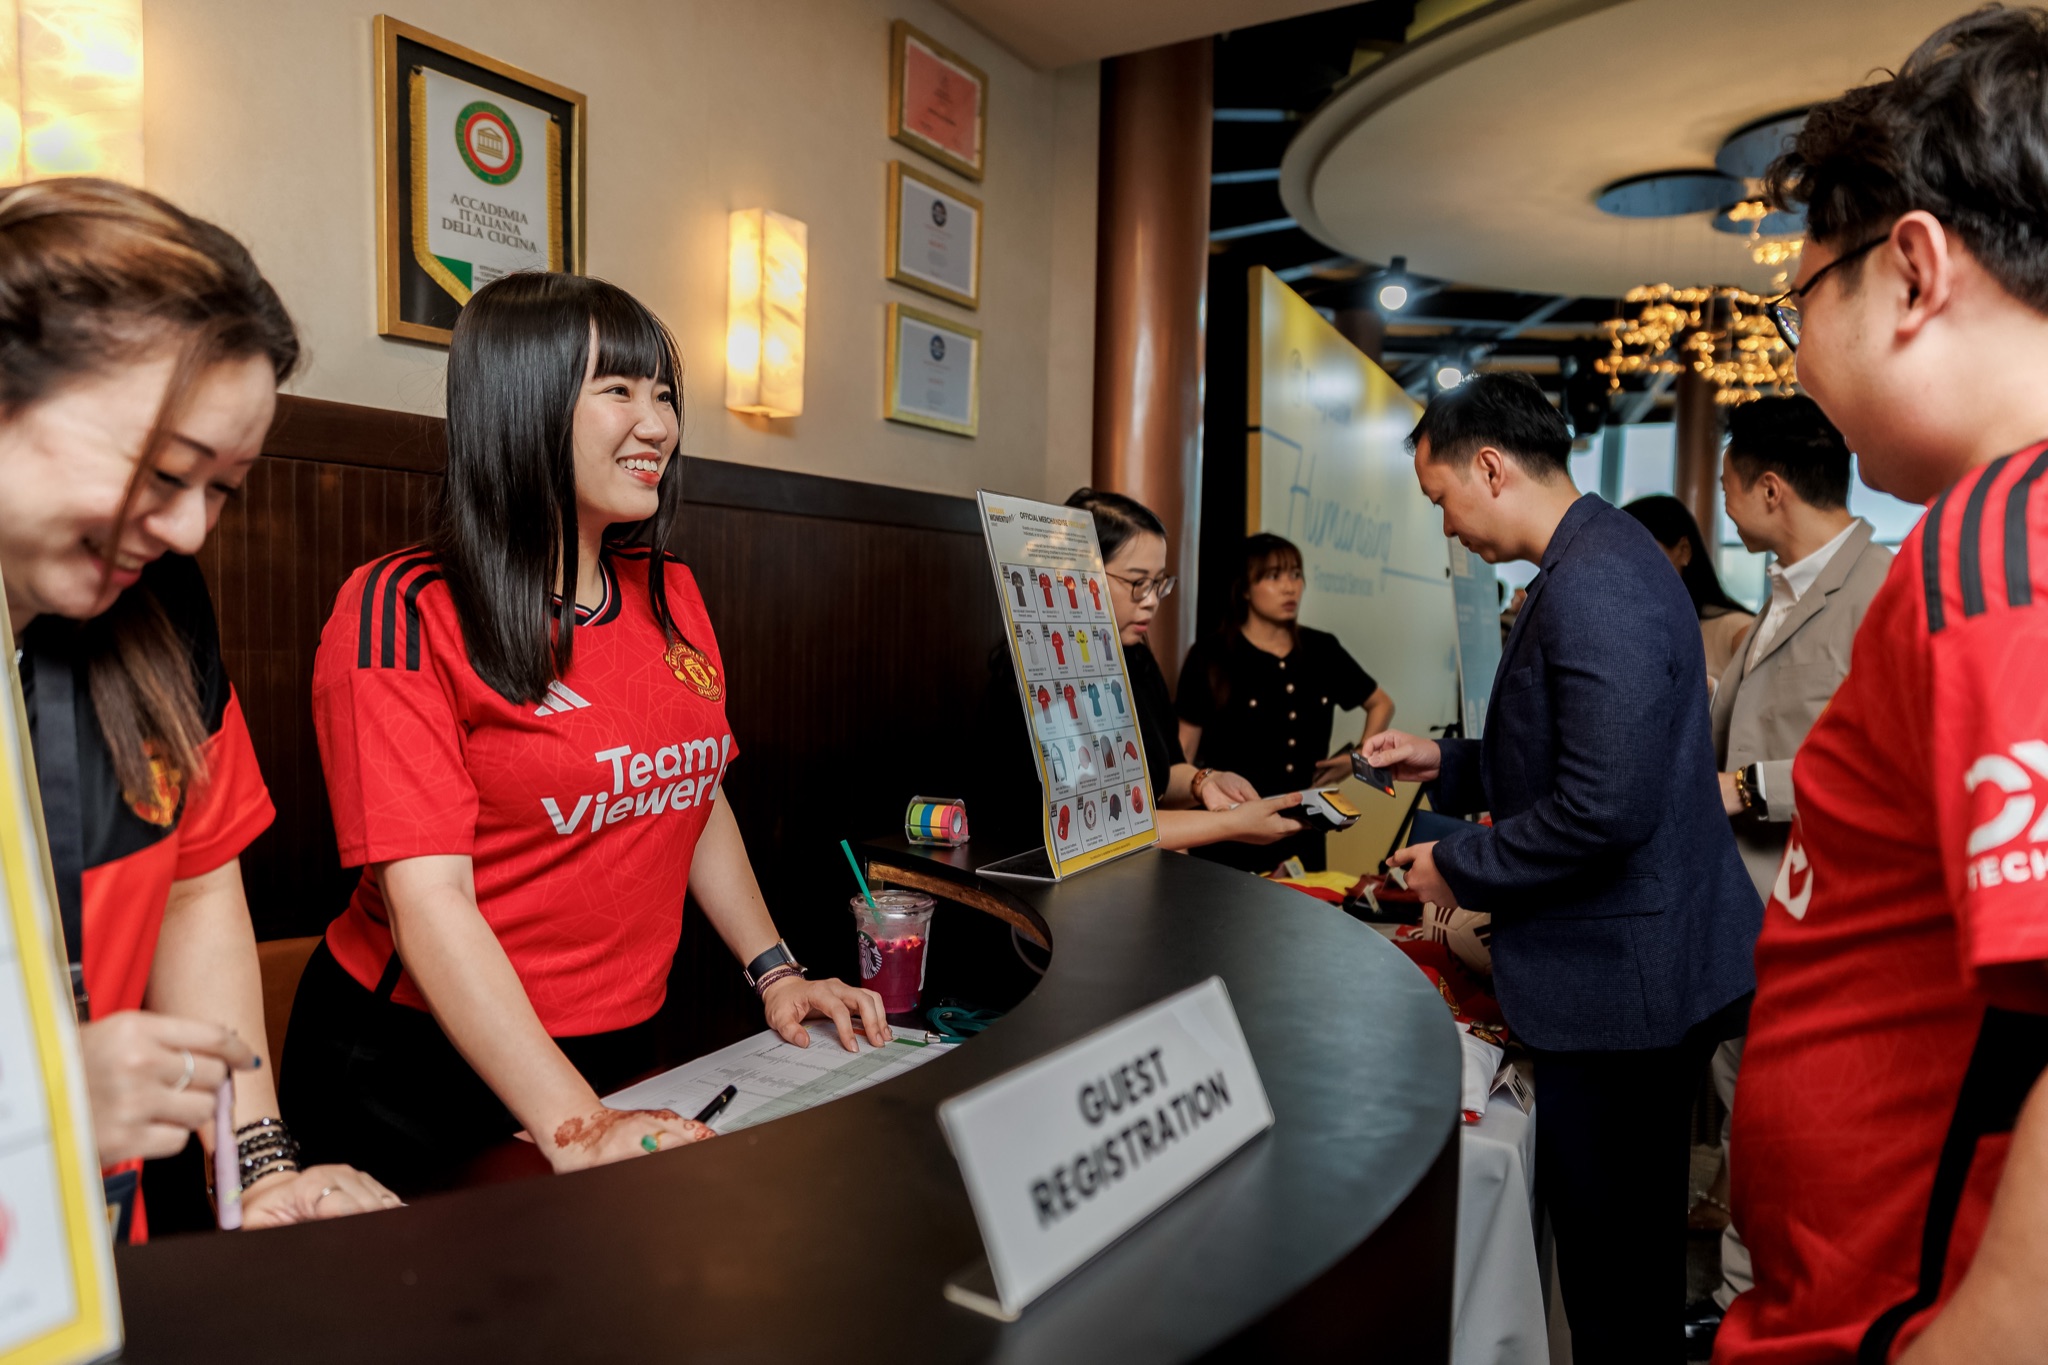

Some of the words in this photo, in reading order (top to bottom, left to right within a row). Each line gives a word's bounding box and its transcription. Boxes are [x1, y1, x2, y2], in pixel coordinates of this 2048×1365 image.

[441, 217, 484, 239] DELLA
[488, 230, 538, 253] CUCINA
[450, 193, 528, 225] ACCADEMIA
[459, 208, 521, 236] ITALIANA
[594, 735, 719, 795] Team
[540, 773, 713, 835] Viewer
[1077, 1046, 1169, 1128] GUEST
[1029, 1070, 1233, 1230] REGISTRATION
